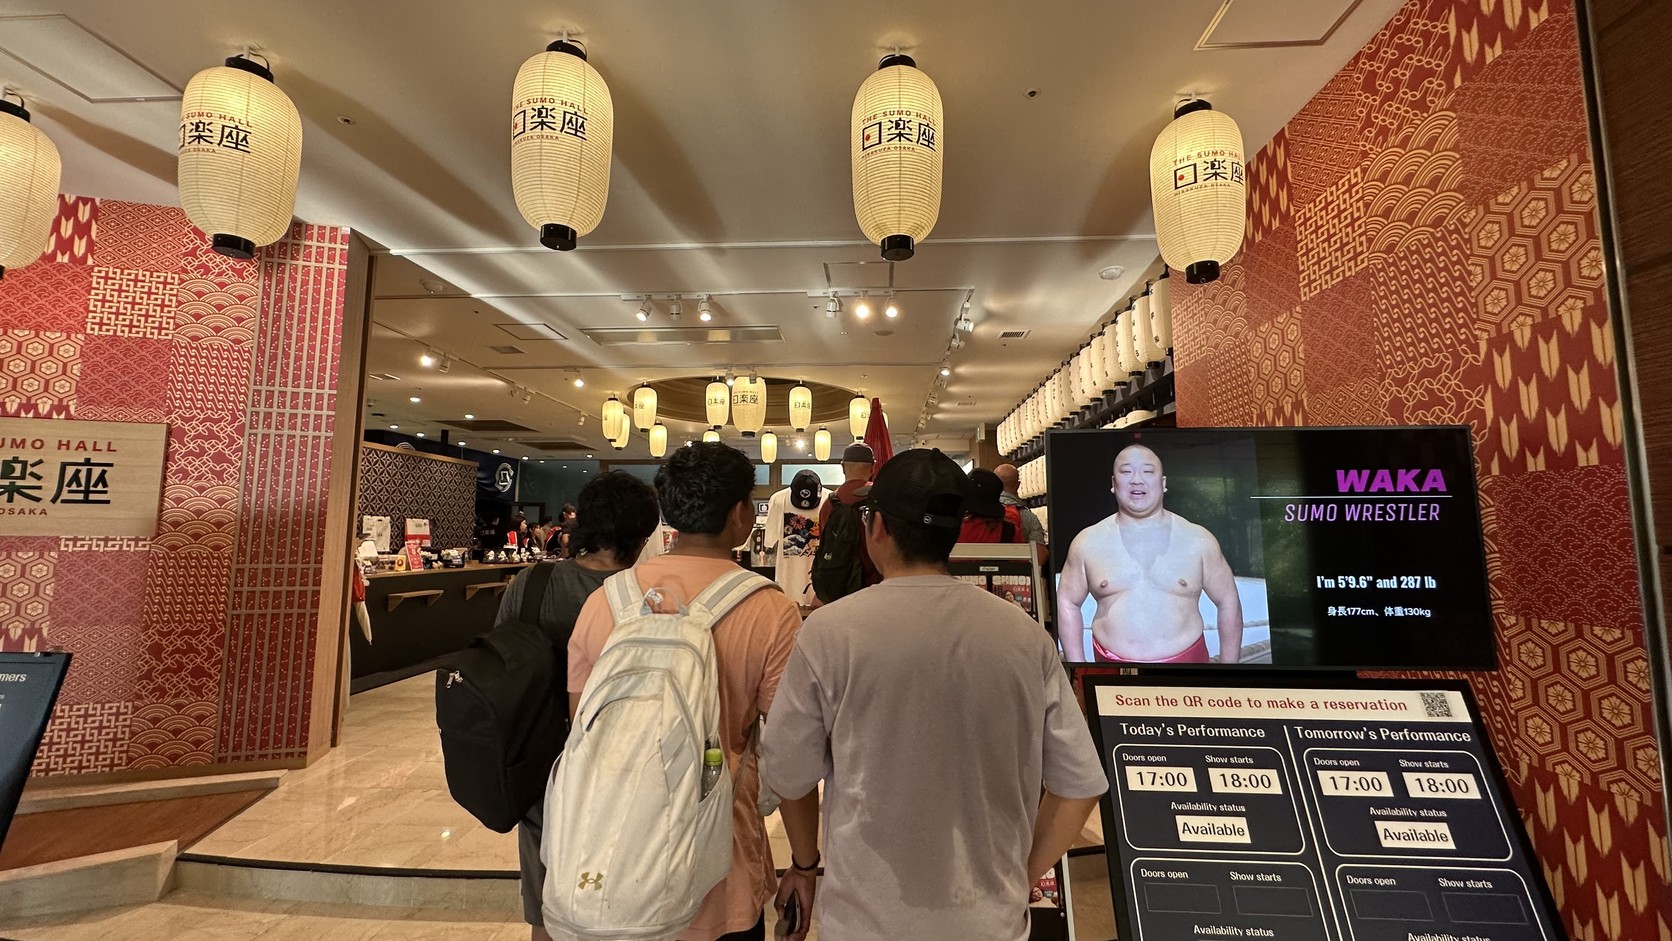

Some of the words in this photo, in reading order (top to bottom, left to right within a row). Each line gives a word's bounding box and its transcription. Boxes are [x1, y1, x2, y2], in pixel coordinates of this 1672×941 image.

[526, 97, 555, 105] SUMO
[560, 99, 588, 114] HALL
[218, 114, 252, 128] HALL
[915, 112, 936, 126] HALL
[1197, 150, 1225, 158] SUMO
[57, 439, 117, 452] HALL
[1336, 469, 1447, 492] WAKA
[0, 507, 47, 516] OSAKA
[1285, 504, 1338, 521] SUMO
[1345, 503, 1440, 521] WRESTLER
[1316, 576, 1335, 588] I'm
[1376, 576, 1398, 588] and
[1400, 576, 1421, 588] 287
[1424, 576, 1436, 588] lb
[1115, 694, 1150, 707] Scan
[1155, 695, 1178, 707] the
[1183, 696, 1203, 707] QR
[1207, 696, 1242, 708] code
[1247, 698, 1262, 708] to
[1267, 698, 1305, 709] make
[1309, 700, 1319, 709] a
[1323, 699, 1408, 711] reservation
[1120, 723, 1174, 737] Today's
[1177, 724, 1265, 738] Performance
[1294, 726, 1377, 741] Tomorrow's
[1379, 728, 1471, 742] Performance
[1122, 753, 1146, 762] Doors
[1147, 755, 1167, 763] open
[1205, 755, 1228, 763] Show
[1229, 756, 1254, 764] starts
[1314, 757, 1338, 766] Doors
[1339, 759, 1360, 767] open
[1399, 759, 1422, 768] Show
[1424, 760, 1449, 768] starts
[1136, 772, 1187, 787] 17:00
[1219, 773, 1272, 789] 18:00
[1329, 776, 1382, 792] 17:00
[1415, 777, 1469, 794] 18:00
[1171, 801, 1218, 812] Availability
[1219, 803, 1246, 812] status
[1370, 806, 1418, 817] Availability
[1419, 809, 1447, 817] status
[1182, 822, 1245, 837] Available
[1383, 828, 1449, 843] Available
[1140, 868, 1166, 878] Doors
[1167, 870, 1189, 879] open
[1229, 871, 1255, 881] Show
[1256, 873, 1282, 882] starts
[1346, 875, 1373, 885] Doors
[1374, 877, 1396, 886] open
[1438, 878, 1464, 887] Show
[1466, 880, 1493, 889] starts
[1193, 924, 1244, 937] Availability
[1245, 927, 1275, 937] status
[1408, 932, 1460, 941] Availability
